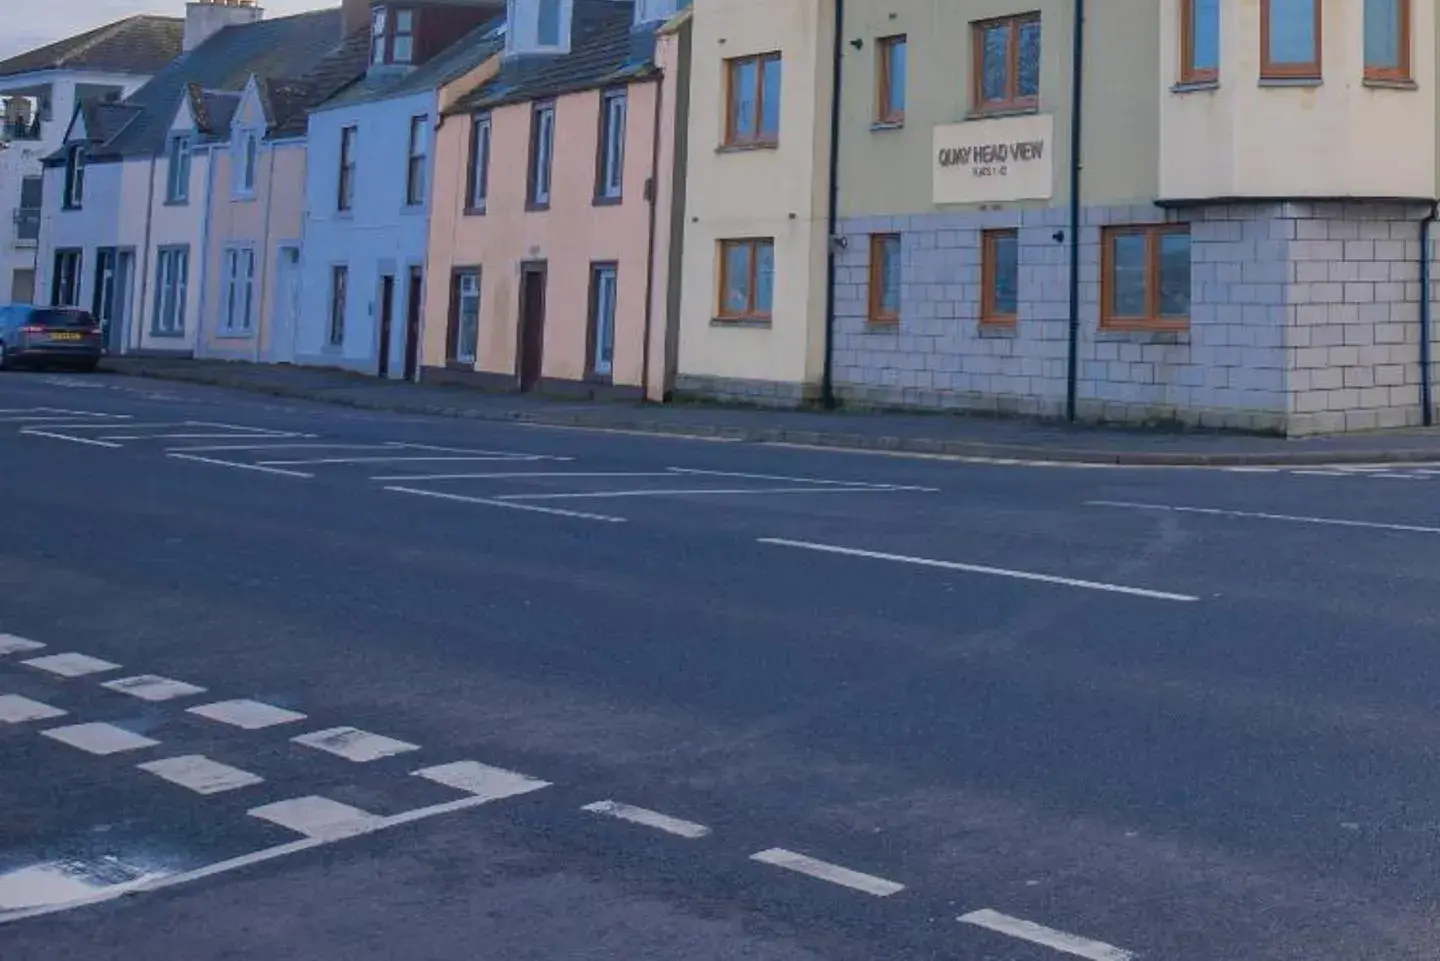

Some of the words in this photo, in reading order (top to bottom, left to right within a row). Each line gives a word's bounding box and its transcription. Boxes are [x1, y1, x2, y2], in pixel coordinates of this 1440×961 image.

[939, 146, 971, 167] QUAY
[973, 143, 1008, 164] HEAD
[1010, 139, 1044, 161] VIEW
